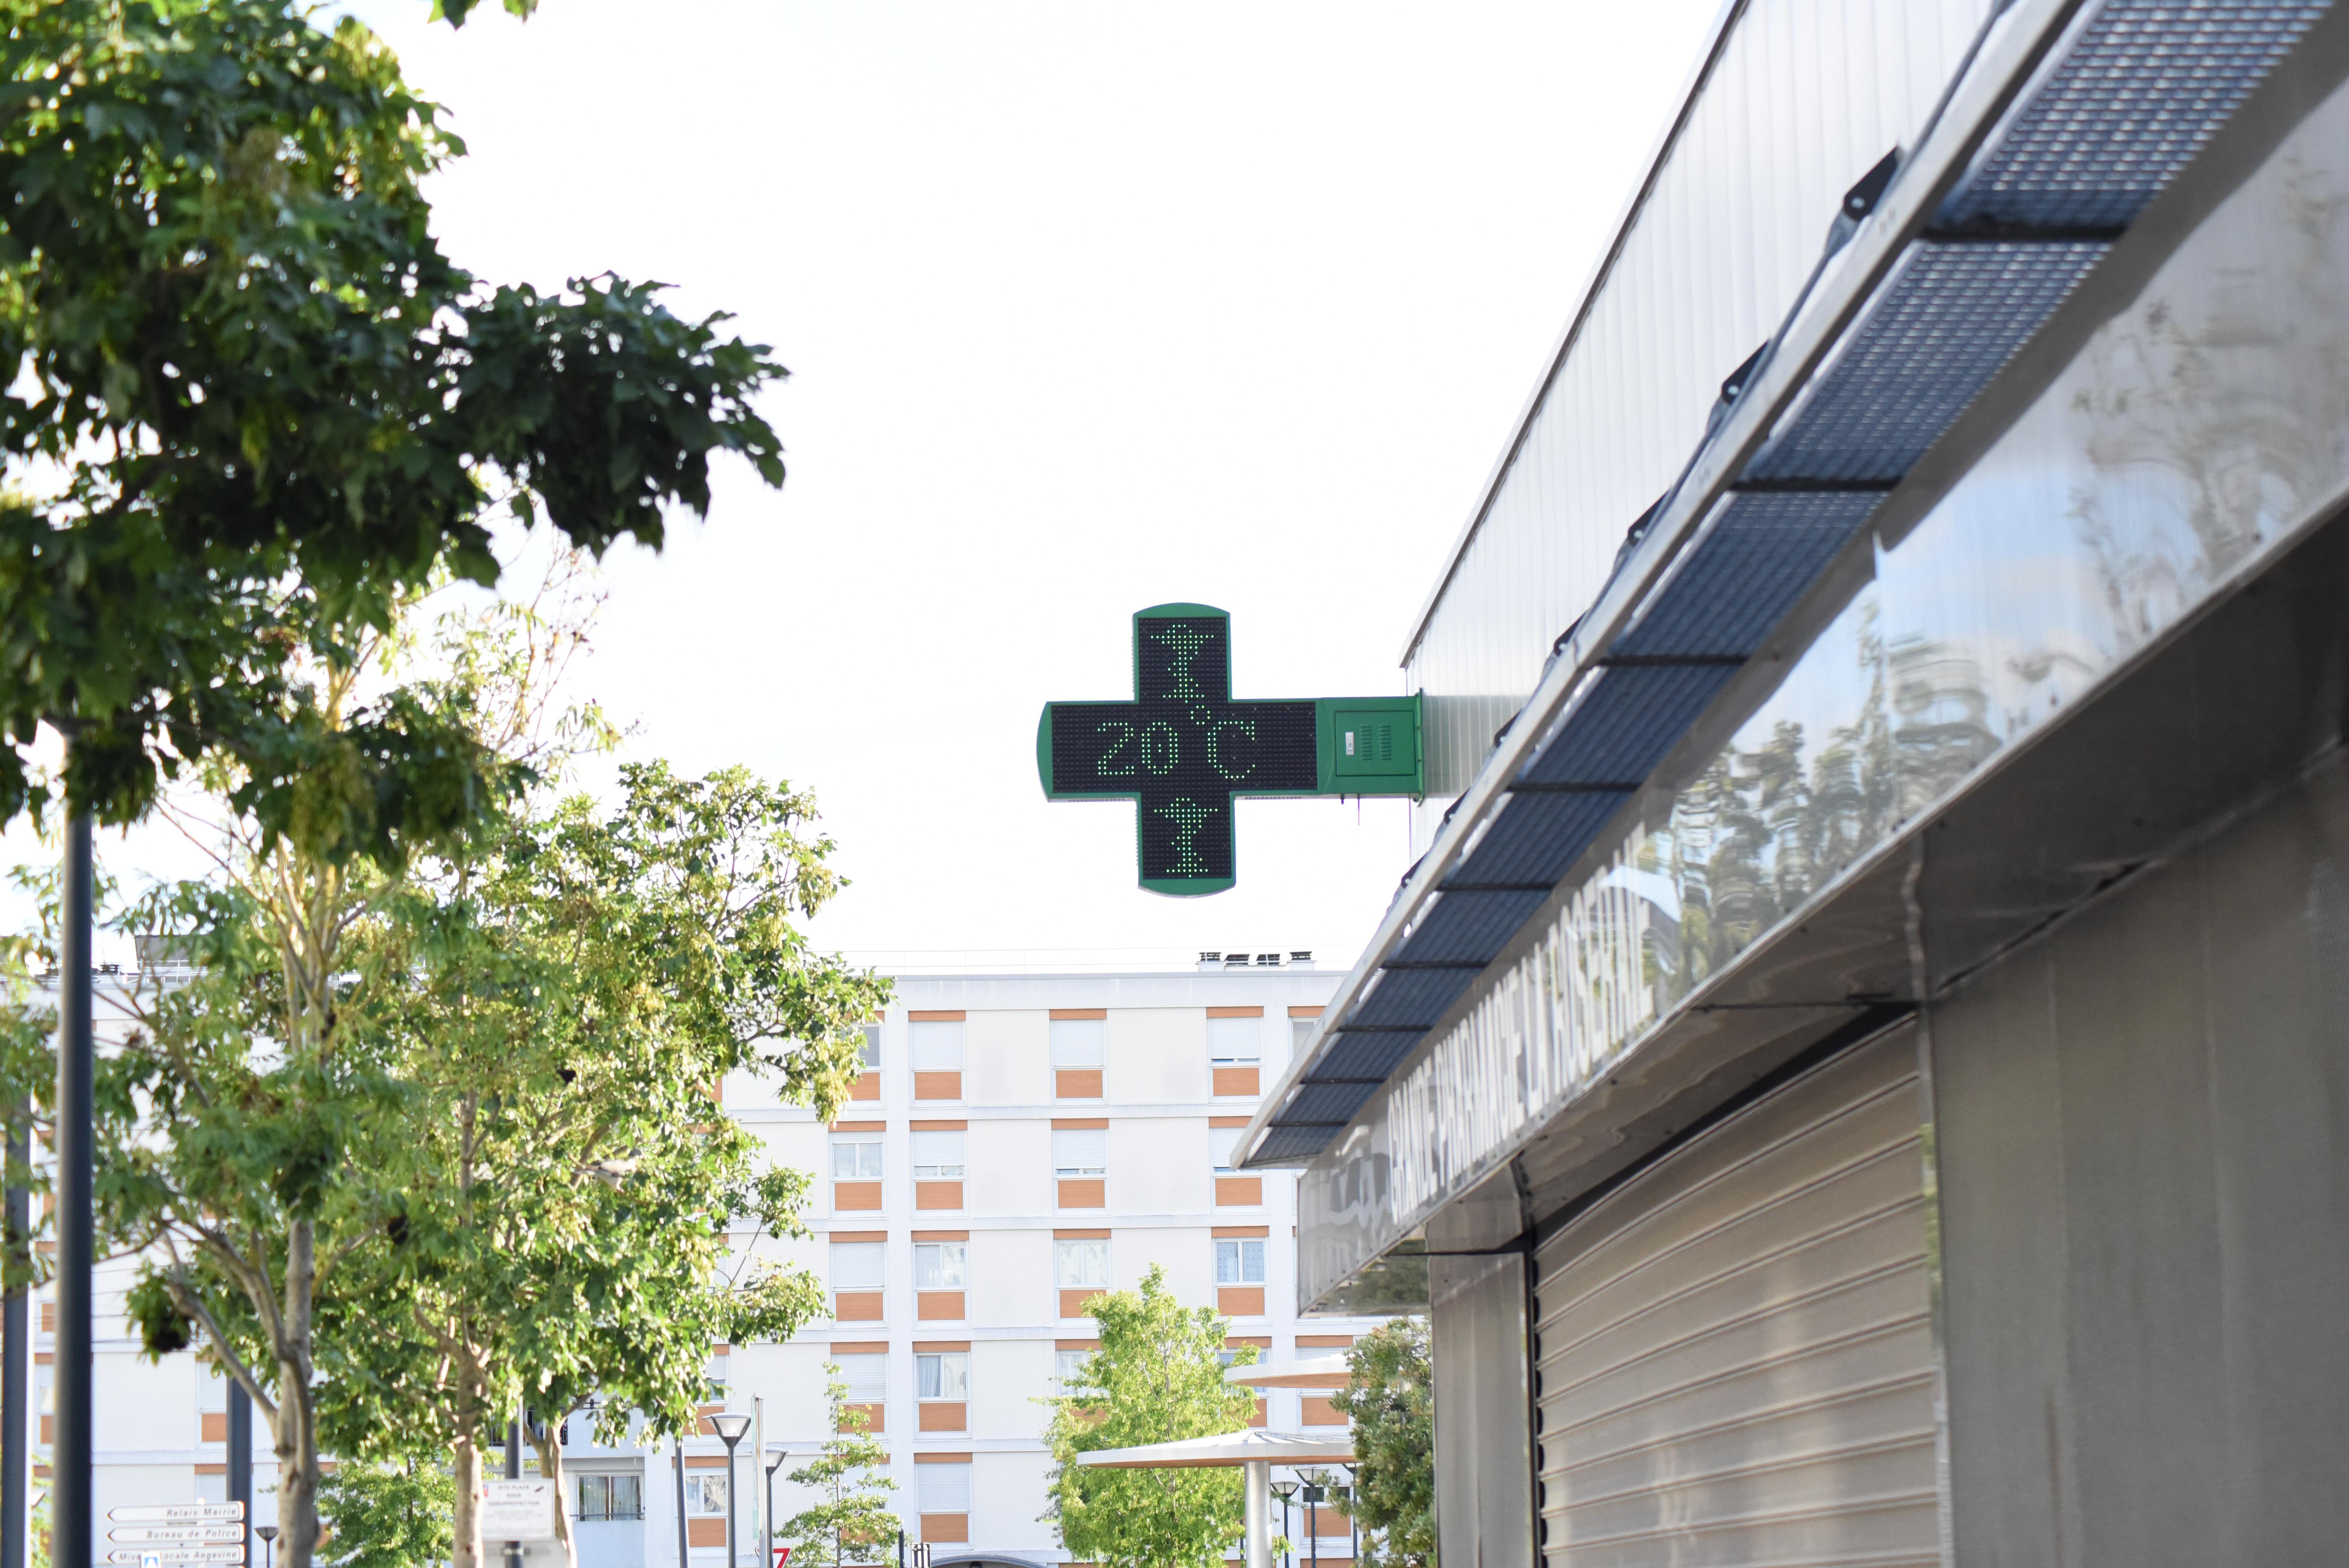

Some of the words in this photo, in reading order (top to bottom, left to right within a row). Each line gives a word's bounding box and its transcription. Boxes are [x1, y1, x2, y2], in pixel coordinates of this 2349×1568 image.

[1388, 1056, 1438, 1224] GRANDE
[1433, 965, 1524, 1187] PHARMACIE
[1520, 942, 1550, 1118] LA
[1548, 821, 1654, 1094] ROSERAIE
[167, 1508, 198, 1517] Relais
[203, 1507, 236, 1516] Mairie
[147, 1530, 182, 1539] Bureau
[188, 1530, 199, 1538] de
[205, 1529, 237, 1538] Police
[194, 1551, 237, 1562] Angevine
